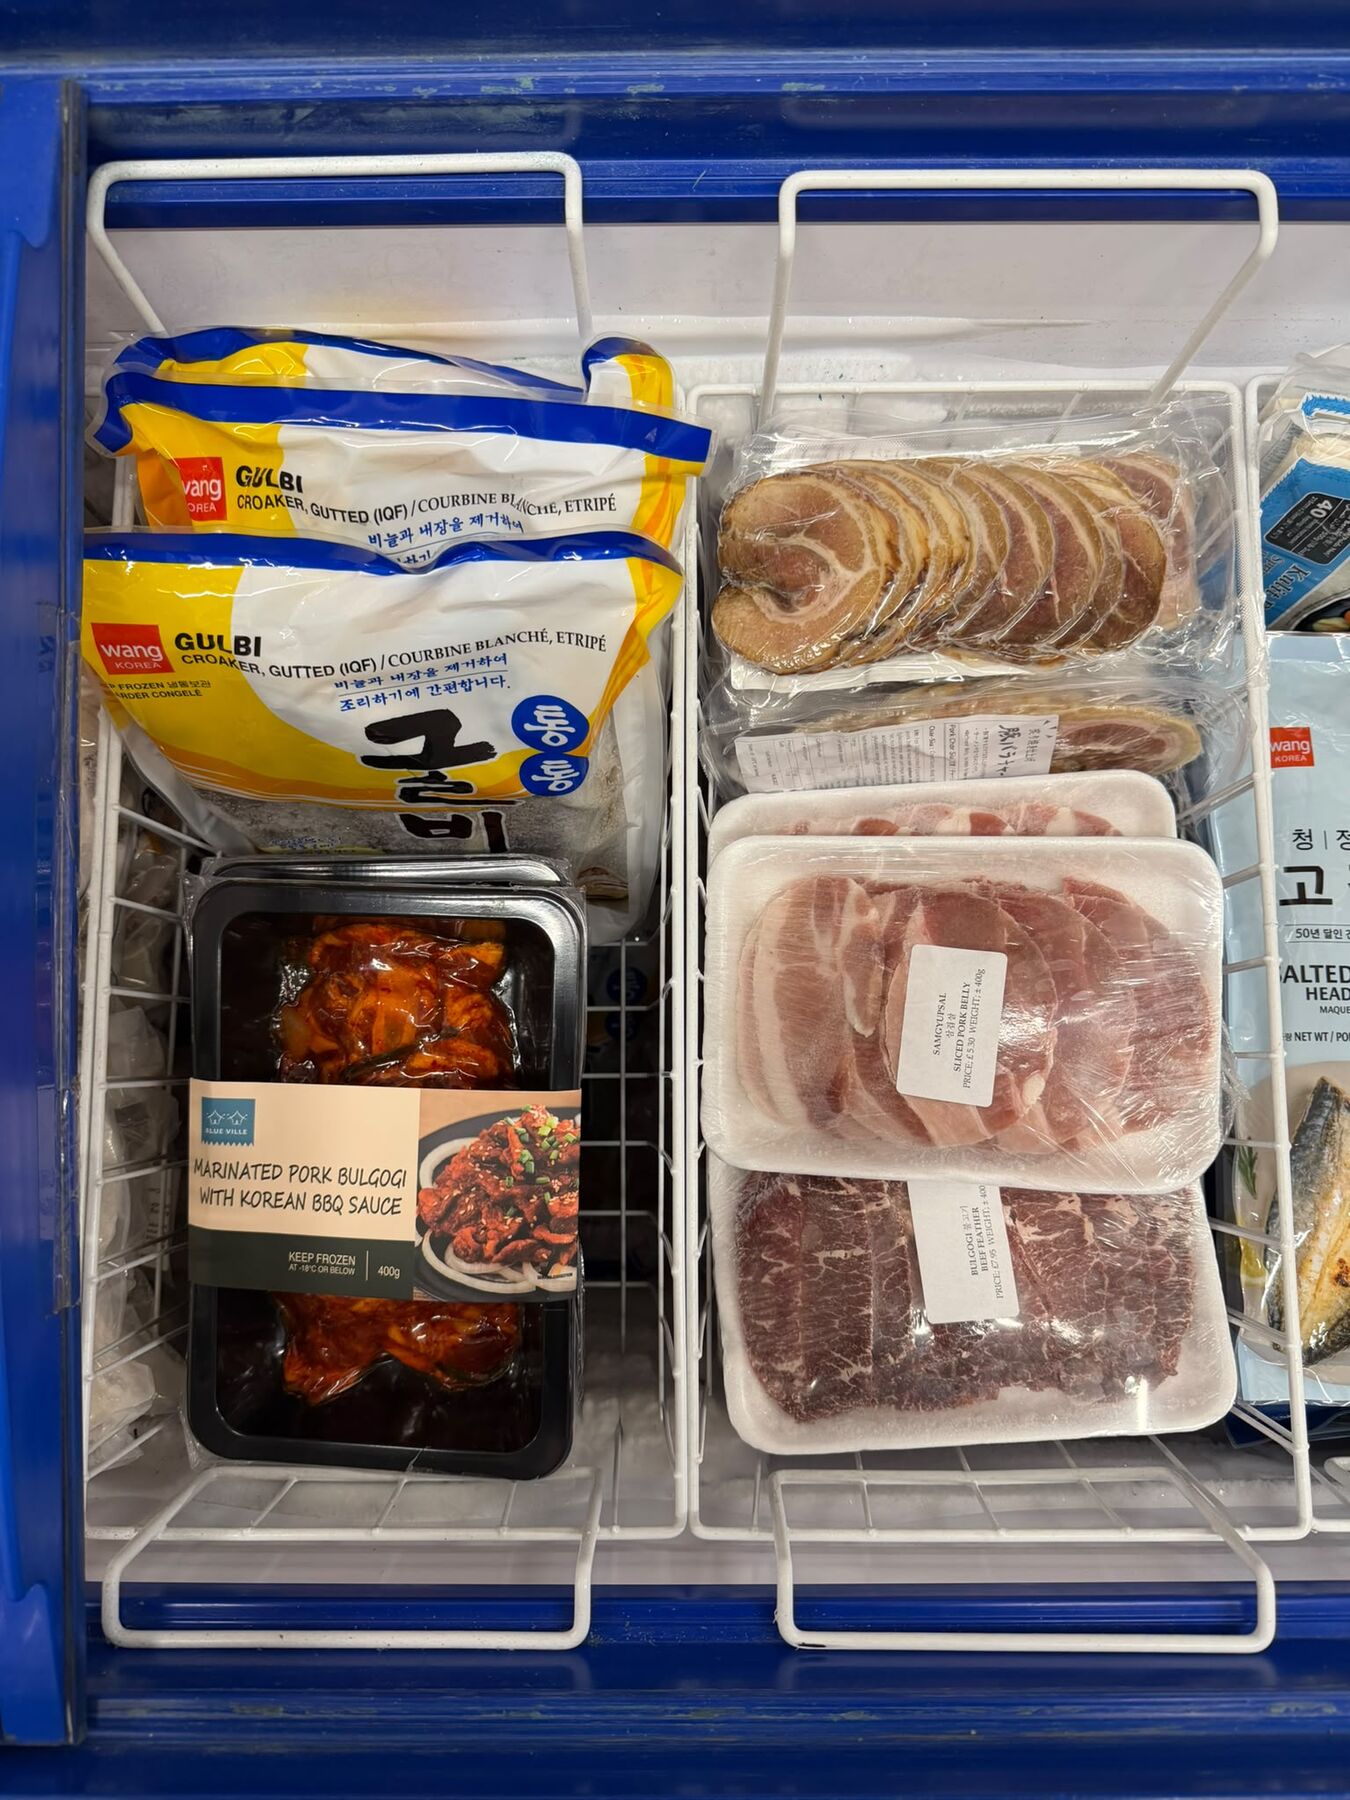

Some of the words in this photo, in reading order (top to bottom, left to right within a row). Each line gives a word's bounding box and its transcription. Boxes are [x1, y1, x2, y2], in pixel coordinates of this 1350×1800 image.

[235, 466, 303, 494] GULBI
[187, 502, 217, 513] OREA
[236, 494, 308, 514] CROAKER,
[310, 504, 370, 524] GUTTED
[373, 504, 409, 526] (IQF)
[419, 492, 498, 512] COURBINE
[564, 493, 617, 513] ETRIPÉ
[368, 528, 414, 549] 비늘과
[420, 517, 465, 538] 내장을
[1265, 563, 1311, 599] Kulit
[100, 644, 163, 663] wang
[174, 632, 262, 657] GULBI
[182, 654, 266, 677] CROAKER,
[268, 666, 335, 679] GUTTED
[338, 657, 377, 677] (IQF)
[387, 643, 472, 666] COURBINE
[475, 628, 553, 650] BLANCHÉ,
[556, 631, 607, 652] ETRIPÉ
[115, 661, 162, 669] KOREA
[334, 677, 384, 690] 비늘과
[390, 668, 439, 683] 내장을
[444, 653, 508, 673] 제거하여
[118, 682, 165, 690] FROZEN
[340, 686, 420, 712] 조리하기에
[426, 674, 511, 697] 간편합니다.
[949, 724, 957, 737] Pork
[1270, 740, 1310, 755] wang
[1292, 829, 1314, 851] 청
[1279, 866, 1350, 906] 고
[1295, 928, 1320, 939] 50년
[1323, 929, 1343, 939] 달인
[974, 969, 986, 987] 400g
[1279, 965, 1350, 984] ALTED
[960, 982, 970, 1010] BELLY
[933, 993, 947, 1055] SAMGYUPSAL
[957, 1012, 967, 1038] PORK
[1294, 1032, 1312, 1042] NET
[1314, 1032, 1329, 1042] WT
[953, 1040, 964, 1072] SLICED
[194, 1158, 283, 1180] MARINATED
[289, 1164, 332, 1184] PORK
[337, 1167, 407, 1188] BULGOGI
[200, 1186, 234, 1206] WITH
[240, 1190, 307, 1211] KOREAN
[312, 1194, 344, 1216] BBQ
[348, 1196, 403, 1215] SAUCE
[972, 1207, 985, 1248] FEATHER
[289, 1251, 314, 1263] KEEP
[316, 1253, 356, 1266] FROZEN
[965, 1233, 978, 1276] BULGOGI
[979, 1248, 988, 1272] BEEF
[288, 1263, 298, 1271] AT
[329, 1266, 356, 1275] BELOW
[377, 1265, 400, 1279] 400g
